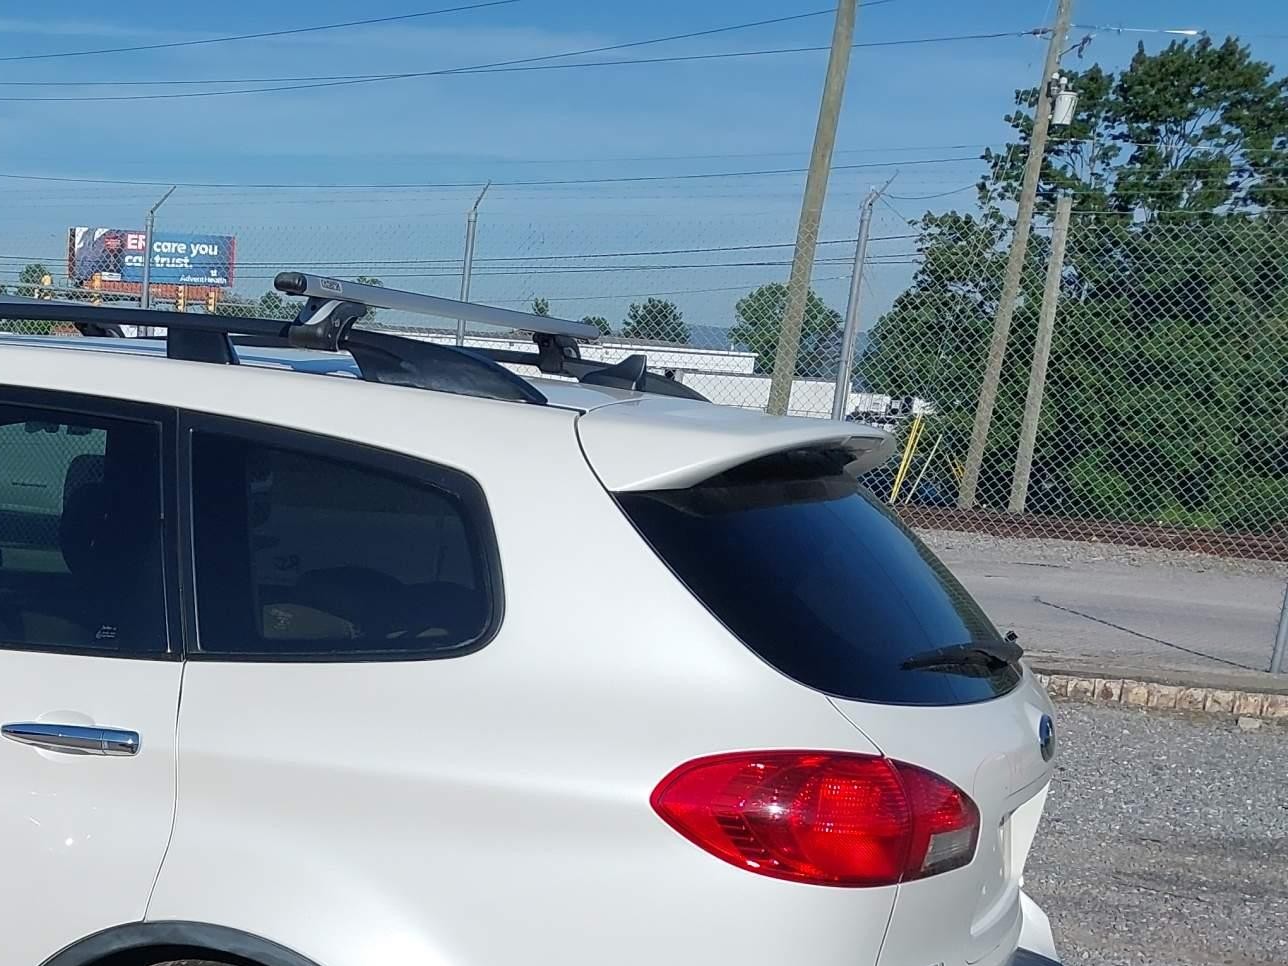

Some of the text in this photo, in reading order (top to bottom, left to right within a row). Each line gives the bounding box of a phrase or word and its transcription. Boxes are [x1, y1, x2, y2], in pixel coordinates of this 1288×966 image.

[153, 241, 187, 254] care
[190, 243, 218, 257] you
[154, 254, 193, 268] trust.
